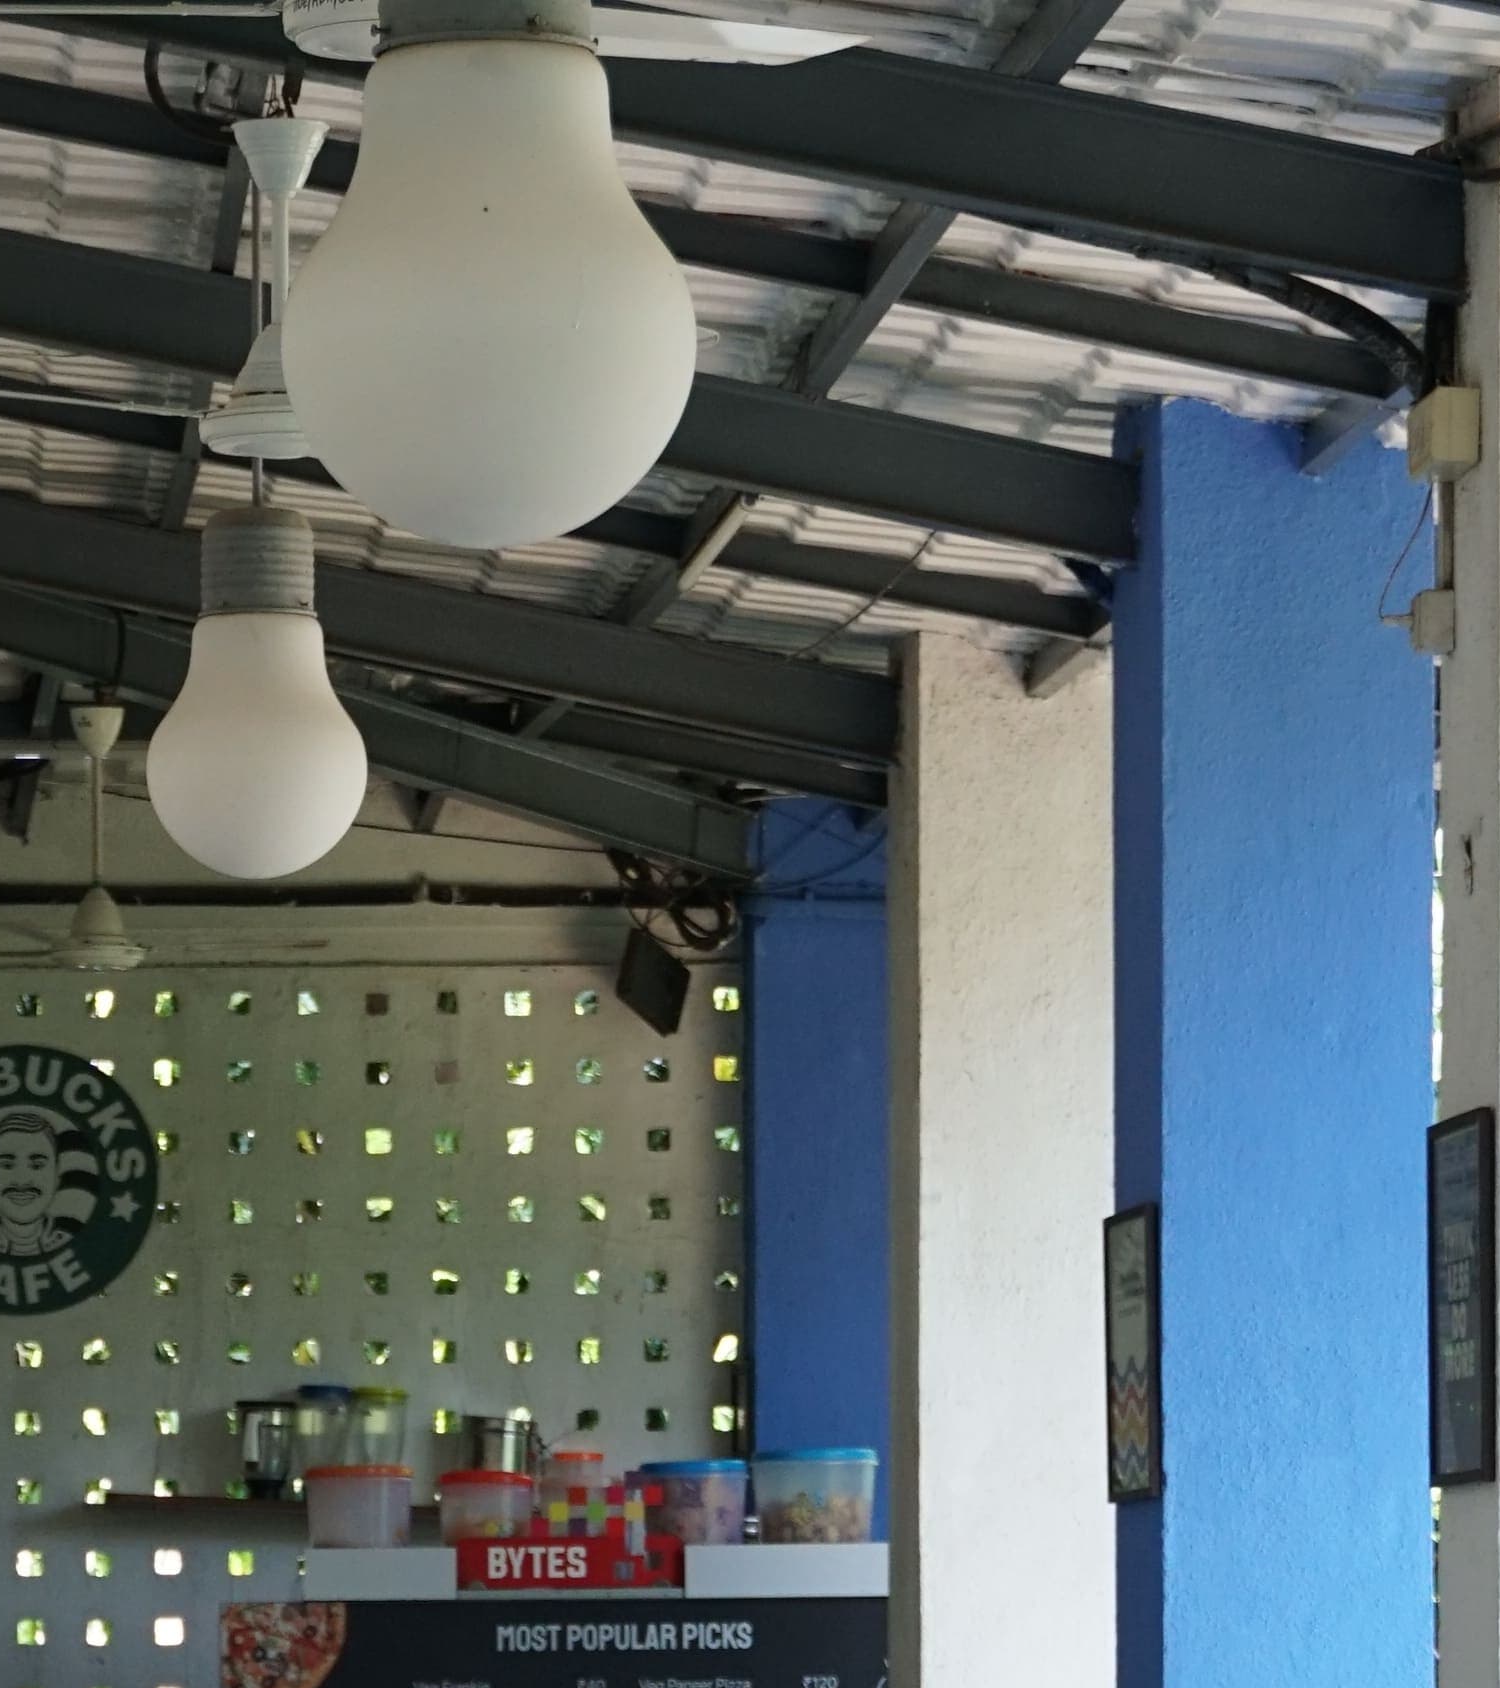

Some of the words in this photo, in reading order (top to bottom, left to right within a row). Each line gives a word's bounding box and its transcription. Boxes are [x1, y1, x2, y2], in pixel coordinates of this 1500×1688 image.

[488, 1546, 588, 1579] BYTES
[496, 1624, 562, 1651] MOST
[566, 1623, 677, 1651] POPULAR
[682, 1622, 753, 1650] PICKS
